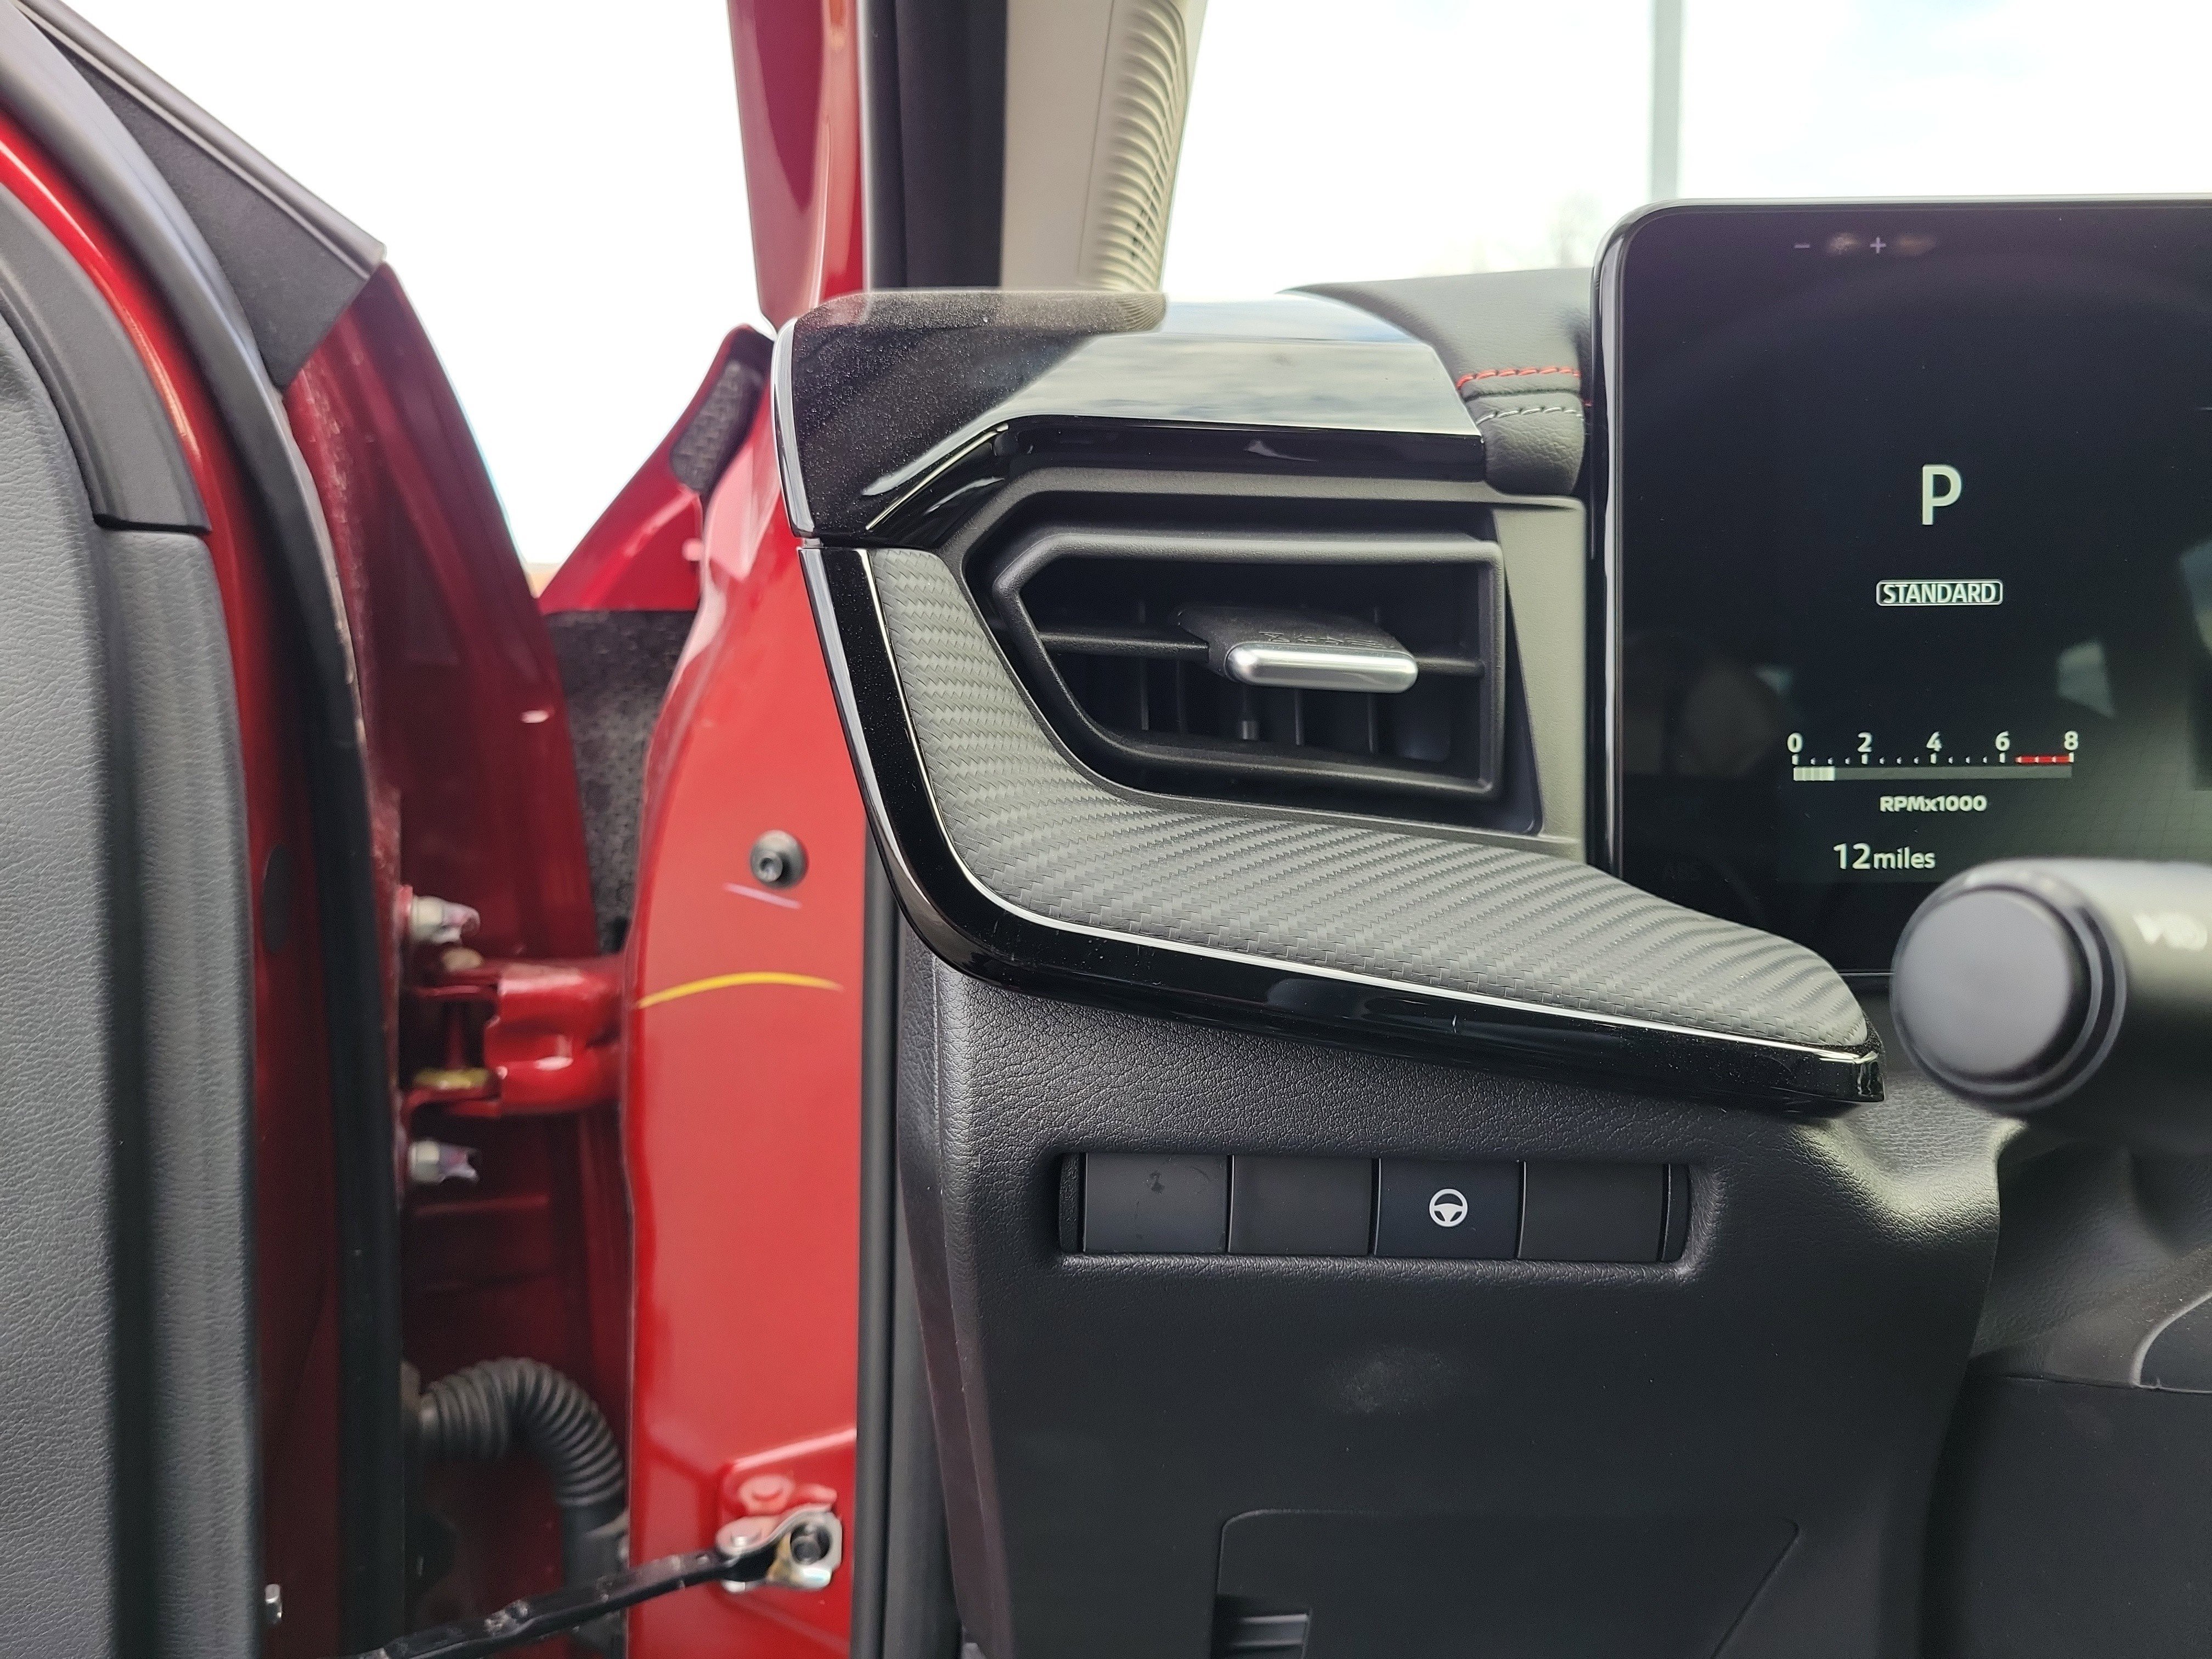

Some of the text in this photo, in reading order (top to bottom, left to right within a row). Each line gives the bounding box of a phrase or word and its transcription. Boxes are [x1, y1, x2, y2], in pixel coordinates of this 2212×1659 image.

[1922, 464, 1962, 526] P
[1882, 583, 1997, 603] STANDARD
[1787, 731, 2079, 753] 0 2 4 6 8
